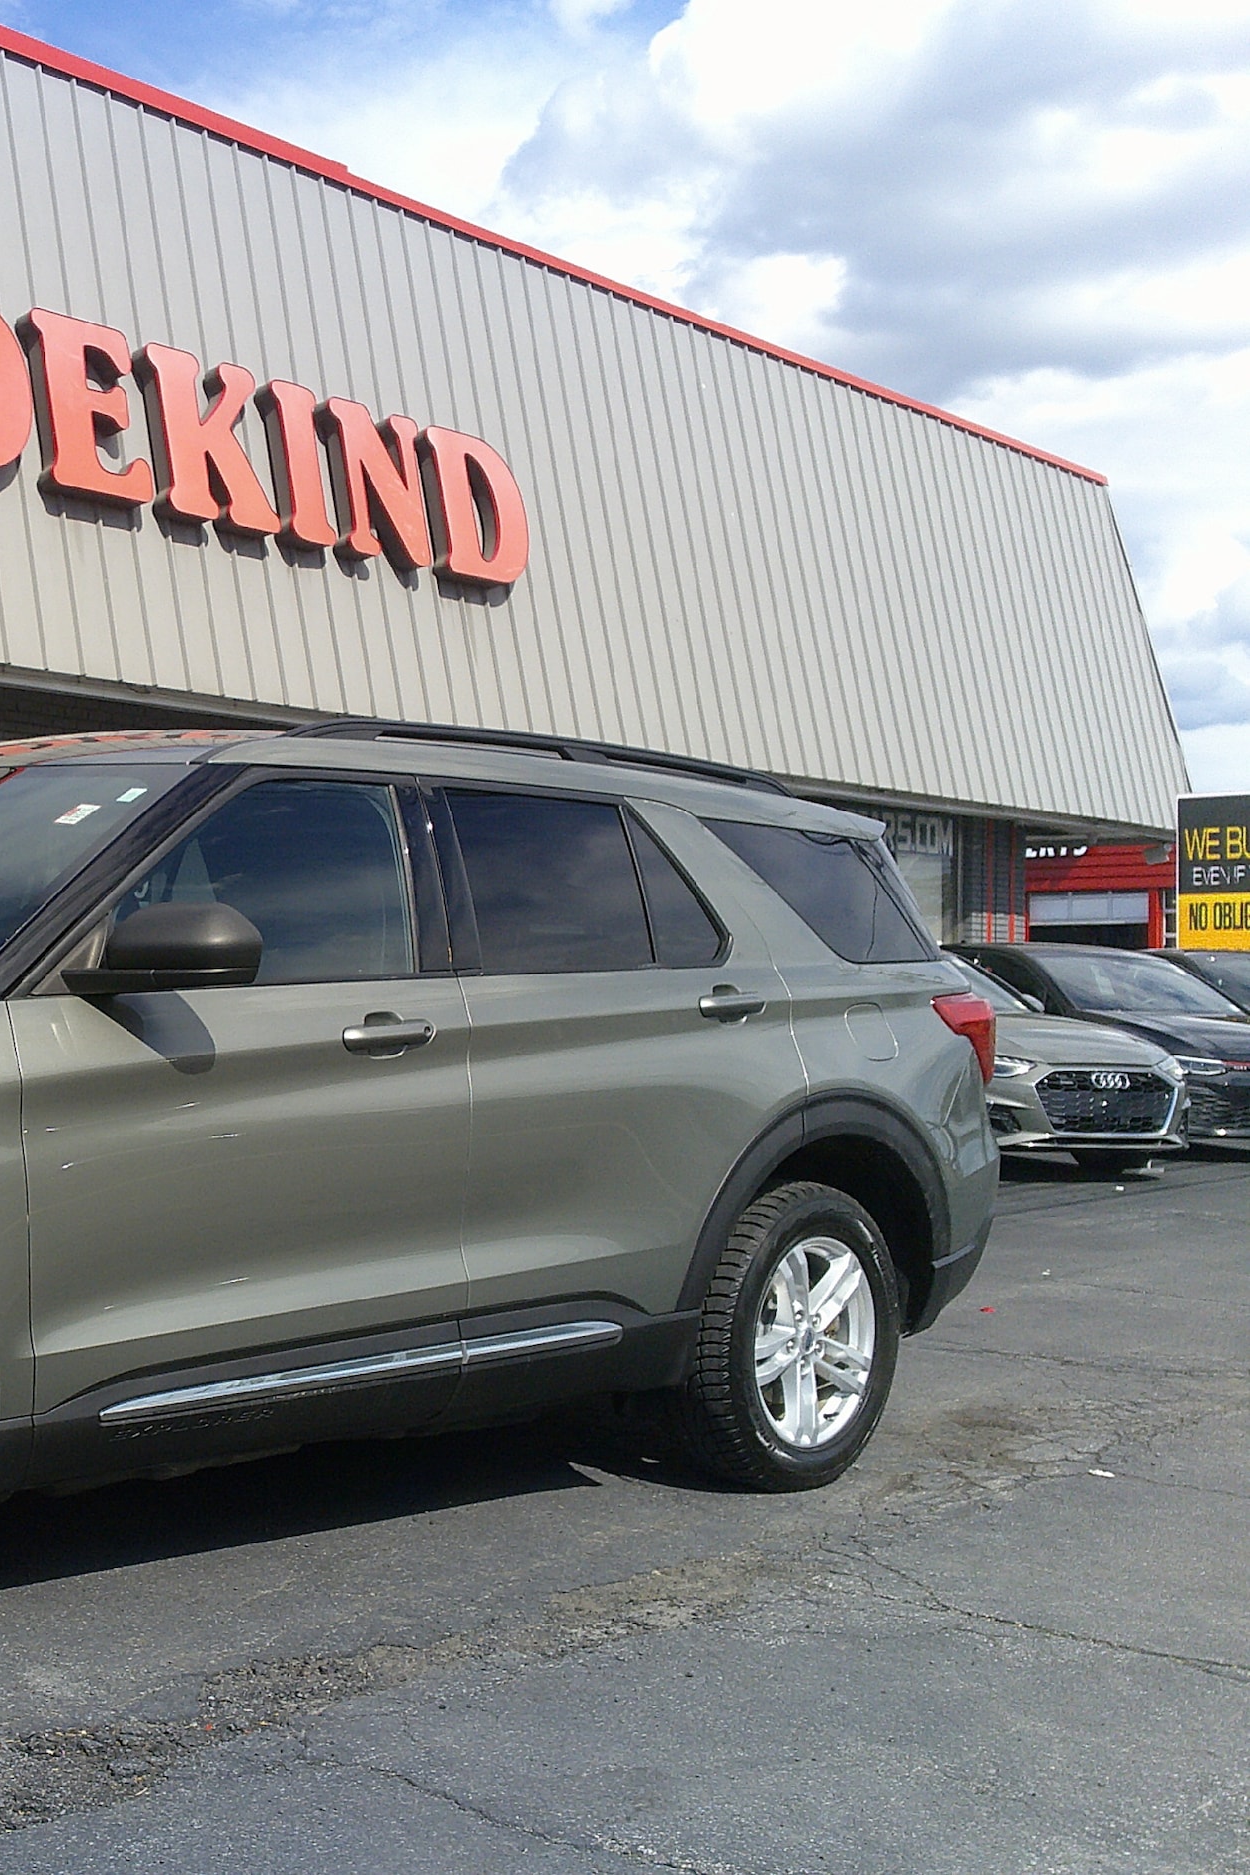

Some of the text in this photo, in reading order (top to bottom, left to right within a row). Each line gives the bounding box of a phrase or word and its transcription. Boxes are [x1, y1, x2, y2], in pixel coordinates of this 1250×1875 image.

[1184, 826, 1221, 861] WE
[1192, 864, 1247, 887] EVEN IF
[1188, 901, 1209, 931] NO
